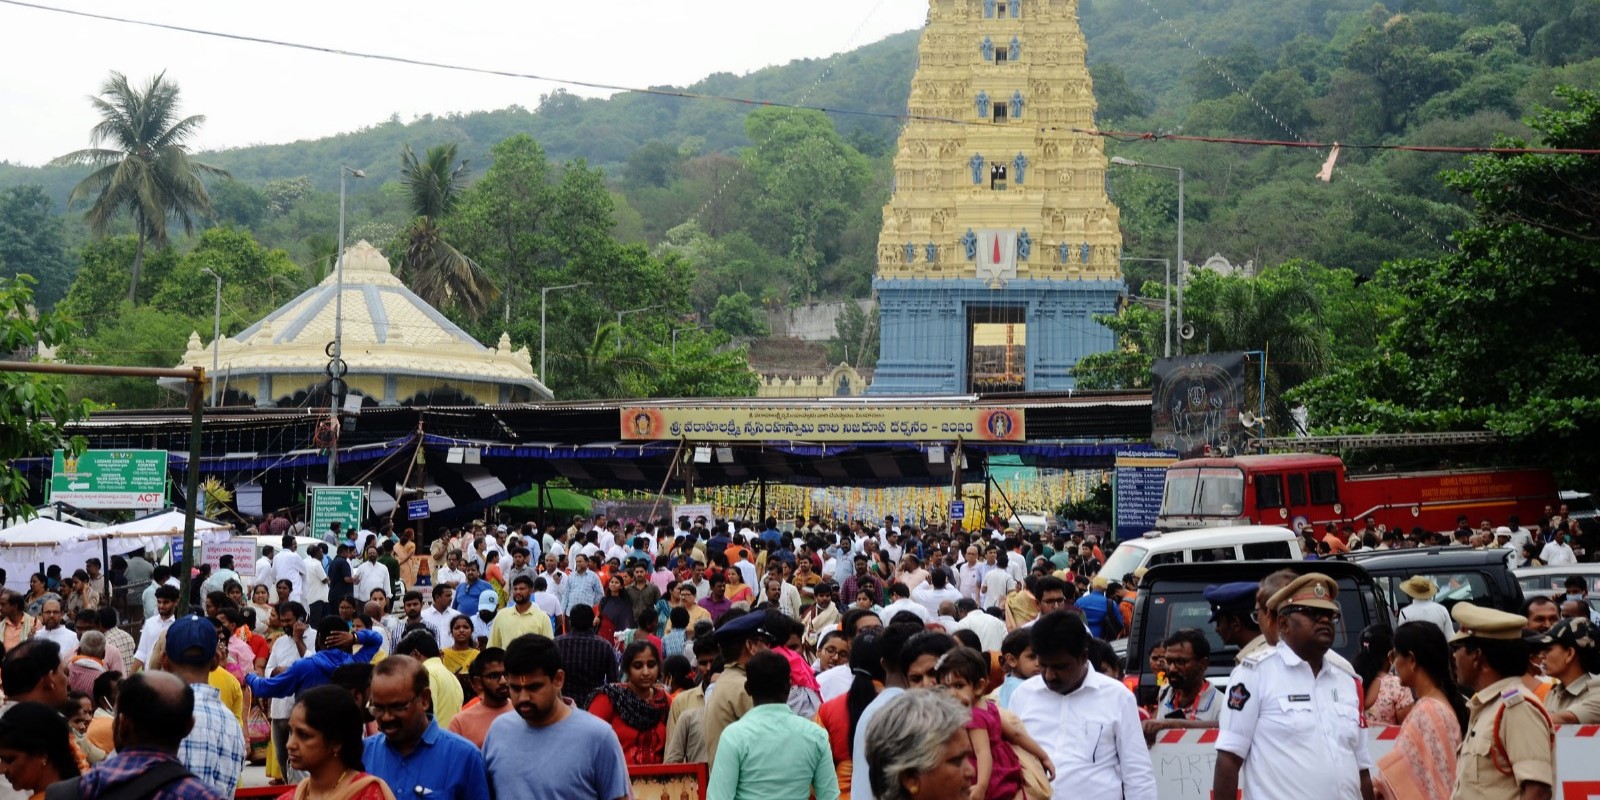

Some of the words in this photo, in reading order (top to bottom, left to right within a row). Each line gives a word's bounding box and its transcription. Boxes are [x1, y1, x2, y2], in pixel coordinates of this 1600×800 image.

[670, 421, 681, 436] శ్రీ
[817, 422, 839, 433] వారి
[1459, 475, 1478, 485] PRADESH
[1479, 475, 1492, 484] STATE
[137, 494, 160, 502] ACT
